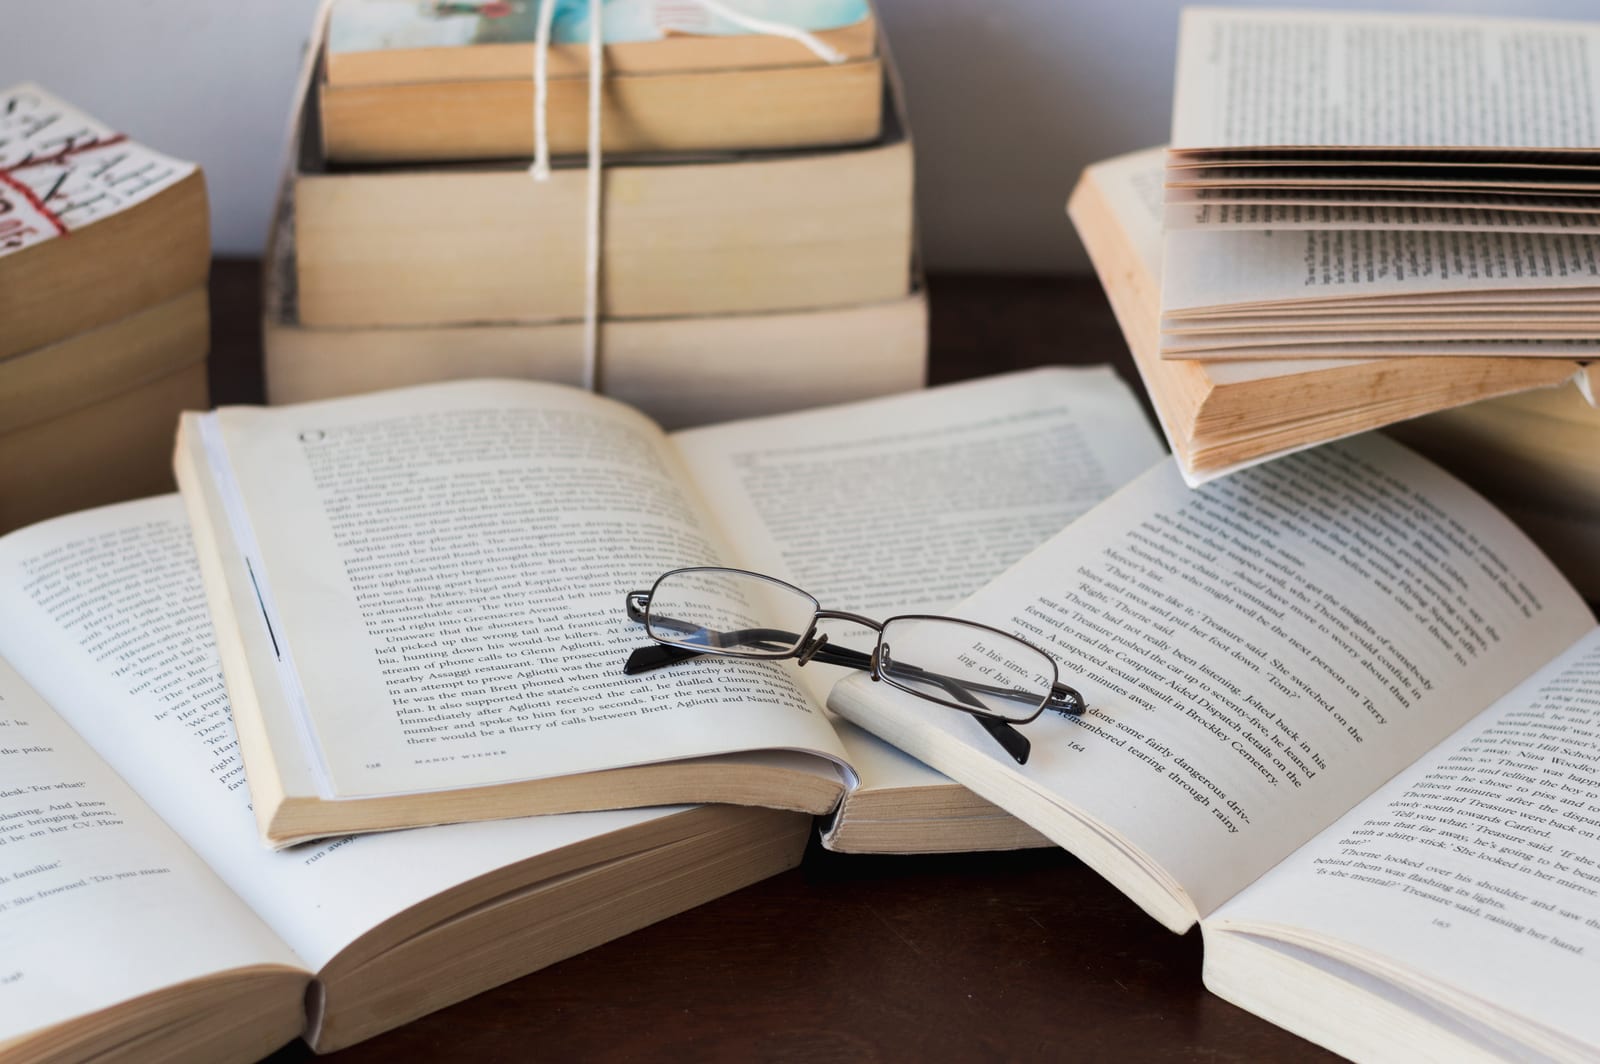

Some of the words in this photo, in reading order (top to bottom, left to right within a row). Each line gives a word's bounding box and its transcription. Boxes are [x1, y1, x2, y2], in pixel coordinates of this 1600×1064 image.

[154, 711, 168, 721] he
[171, 699, 190, 711] was
[193, 683, 224, 700] found
[396, 707, 424, 717] plan.
[428, 703, 438, 711] It
[440, 700, 462, 709] also
[466, 693, 523, 707] supported
[527, 690, 544, 698] the
[547, 685, 579, 697] state's
[582, 675, 642, 691] contention
[669, 667, 720, 678] hierarchy
[400, 711, 471, 725] Immediately
[476, 707, 502, 715] after
[508, 701, 551, 713] Agliotti
[556, 692, 602, 705] received
[607, 688, 627, 697] the
[630, 685, 652, 696] call,
[675, 677, 713, 687] dialled
[718, 676, 759, 684] Clinton
[414, 695, 435, 703] was
[439, 692, 456, 700] the
[461, 688, 486, 697] man
[490, 684, 517, 692] Brett
[523, 677, 564, 690] phoned
[569, 672, 599, 682] when
[694, 658, 724, 667] going
[727, 658, 780, 676] according
[1011, 616, 1044, 637] screen.
[1046, 634, 1056, 642] A
[1057, 639, 1106, 668] suspected
[1106, 665, 1138, 684] sexual
[1138, 683, 1173, 705] assault
[1173, 700, 1185, 711] in
[1186, 708, 1231, 742] Brockley
[1231, 741, 1279, 787] Cemetery.
[1024, 606, 1065, 632] forward
[1063, 624, 1075, 633] to
[1075, 630, 1098, 646] read
[1098, 642, 1115, 655] the
[1115, 651, 1172, 681] Computer
[1166, 680, 1198, 701] Aided
[1197, 697, 1242, 734] Dispatch
[1242, 730, 1273, 759] details
[1272, 758, 1286, 770] on
[1286, 767, 1302, 788] the
[1058, 605, 1070, 614] as
[1071, 612, 1113, 638] Treasure
[1112, 634, 1151, 657] pushed
[1150, 651, 1167, 664] the
[1167, 662, 1184, 674] car
[1184, 673, 1199, 686] up
[1199, 682, 1210, 692] to
[1210, 690, 1269, 737] seventy-five,
[1271, 734, 1284, 748] he
[1284, 743, 1316, 779] leaned
[1063, 659, 1086, 674] only
[1086, 671, 1128, 696] minutes
[1128, 693, 1156, 713] away.
[1065, 593, 1102, 615] Thorne
[1102, 611, 1123, 626] had
[1123, 623, 1144, 636] not
[1143, 631, 1171, 651] really
[1172, 649, 1203, 667] been
[1199, 663, 1242, 696] listening.
[1243, 694, 1276, 720] Jolted
[1276, 718, 1300, 742] back
[1300, 740, 1311, 753] in
[1312, 752, 1327, 771] his
[177, 708, 197, 721] Her
[404, 724, 448, 735] number
[454, 720, 475, 729] and
[480, 716, 513, 728] spoke
[533, 710, 556, 719] him
[560, 707, 576, 715] for
[581, 706, 595, 714] 30
[599, 698, 647, 710] seconds.
[407, 735, 437, 744] there
[441, 731, 477, 741] would
[480, 728, 495, 736] be
[509, 723, 541, 733] flurry
[546, 720, 558, 728] of
[562, 717, 586, 726] calls
[590, 709, 639, 723] between
[641, 704, 672, 714] Brett,
[677, 697, 718, 708] Agliotti
[746, 695, 780, 704] Nassif
[797, 704, 813, 713] the
[972, 642, 984, 652] In
[986, 649, 1003, 661] his
[1004, 657, 1029, 677] time,
[1088, 708, 1116, 725] done
[1116, 719, 1145, 740] some
[1145, 737, 1173, 758] fairly
[1174, 756, 1227, 800] dangerous
[1227, 798, 1251, 824] driv-
[210, 756, 235, 773] right
[957, 653, 976, 668] ing
[979, 665, 995, 674] of
[994, 673, 1010, 686] his
[1059, 709, 1127, 747] remembered
[1127, 745, 1166, 773] tearing
[1168, 772, 1210, 807] through
[1212, 806, 1239, 835] rainy
[1068, 741, 1085, 752] 164
[10, 834, 25, 842] be
[49, 825, 68, 833] her
[73, 821, 95, 829] CV.
[1423, 804, 1455, 814] south
[1457, 809, 1501, 823] towards
[1504, 820, 1551, 838] Catford.
[1476, 824, 1524, 844] Treasure
[1526, 840, 1553, 853] said.
[305, 851, 325, 865] run
[1386, 832, 1418, 842] shitty
[1452, 845, 1476, 856] She
[1478, 852, 1519, 870] looked
[1519, 865, 1532, 874] in
[1534, 870, 1555, 881] her
[1557, 878, 1598, 897] mirror.
